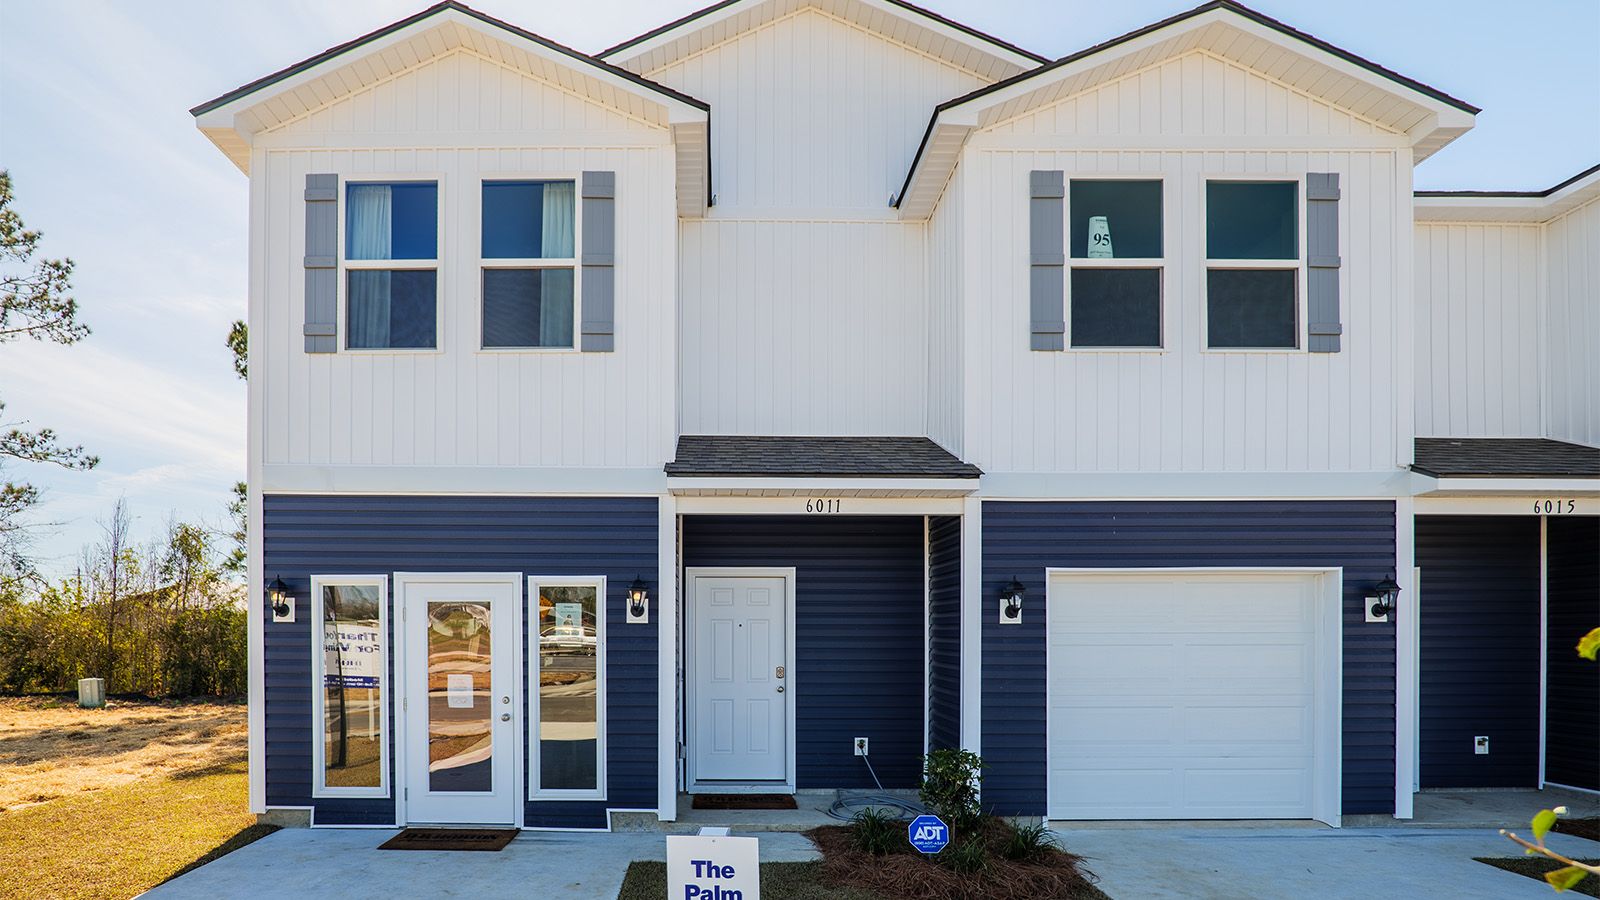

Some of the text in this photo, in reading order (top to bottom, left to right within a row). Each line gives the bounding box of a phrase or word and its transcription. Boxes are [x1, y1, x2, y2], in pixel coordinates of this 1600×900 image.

[1094, 233, 1110, 246] 95
[806, 498, 840, 513] 6011
[1534, 499, 1575, 514] 6015
[913, 826, 944, 841] ADT
[690, 859, 736, 880] The
[684, 884, 743, 900] Palm
